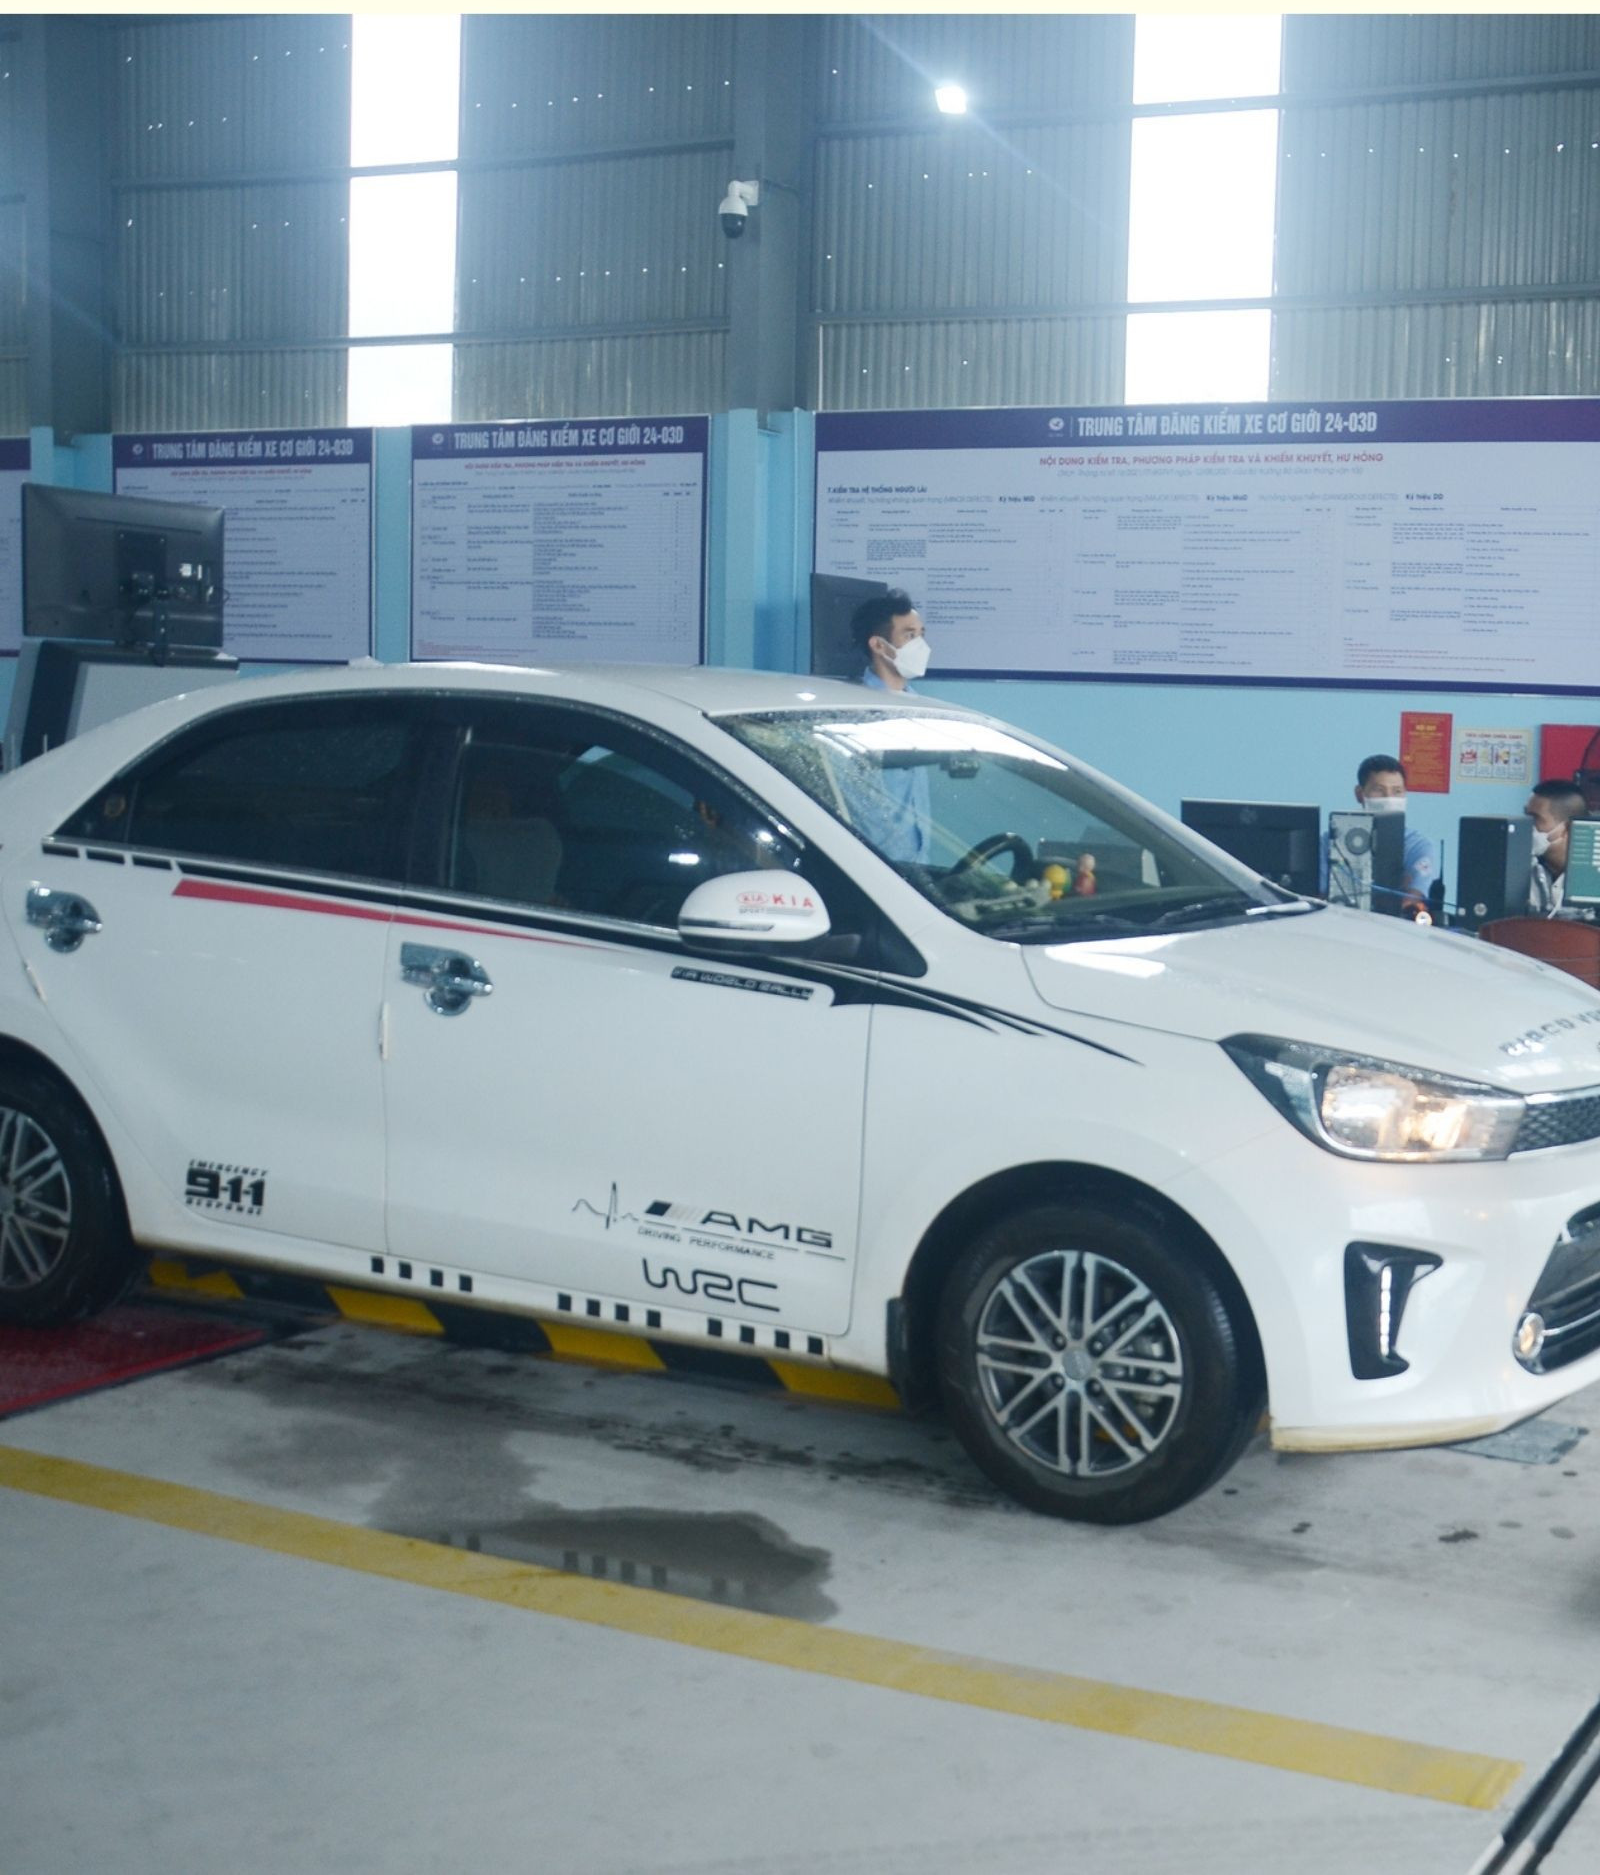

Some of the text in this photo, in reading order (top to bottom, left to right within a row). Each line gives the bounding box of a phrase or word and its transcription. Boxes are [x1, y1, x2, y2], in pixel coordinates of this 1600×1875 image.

[454, 423, 684, 450] TRUNG TÂM ĐĂNG KIỂM XE CƠ GIỚI 24-03D
[1078, 407, 1377, 437] TRUNG TÂM ĐĂNG KIỂM XE CƠ GIỚI 24-03D
[152, 435, 353, 460] TRUNG TÂM ĐĂNG KIỂM XE CƠ GIỚI 24-03D
[772, 893, 814, 908] KIA
[638, 1227, 776, 1260] DRIVING PERFORMANCE
[701, 1210, 832, 1249] AMG
[642, 1257, 781, 1312] WRC
